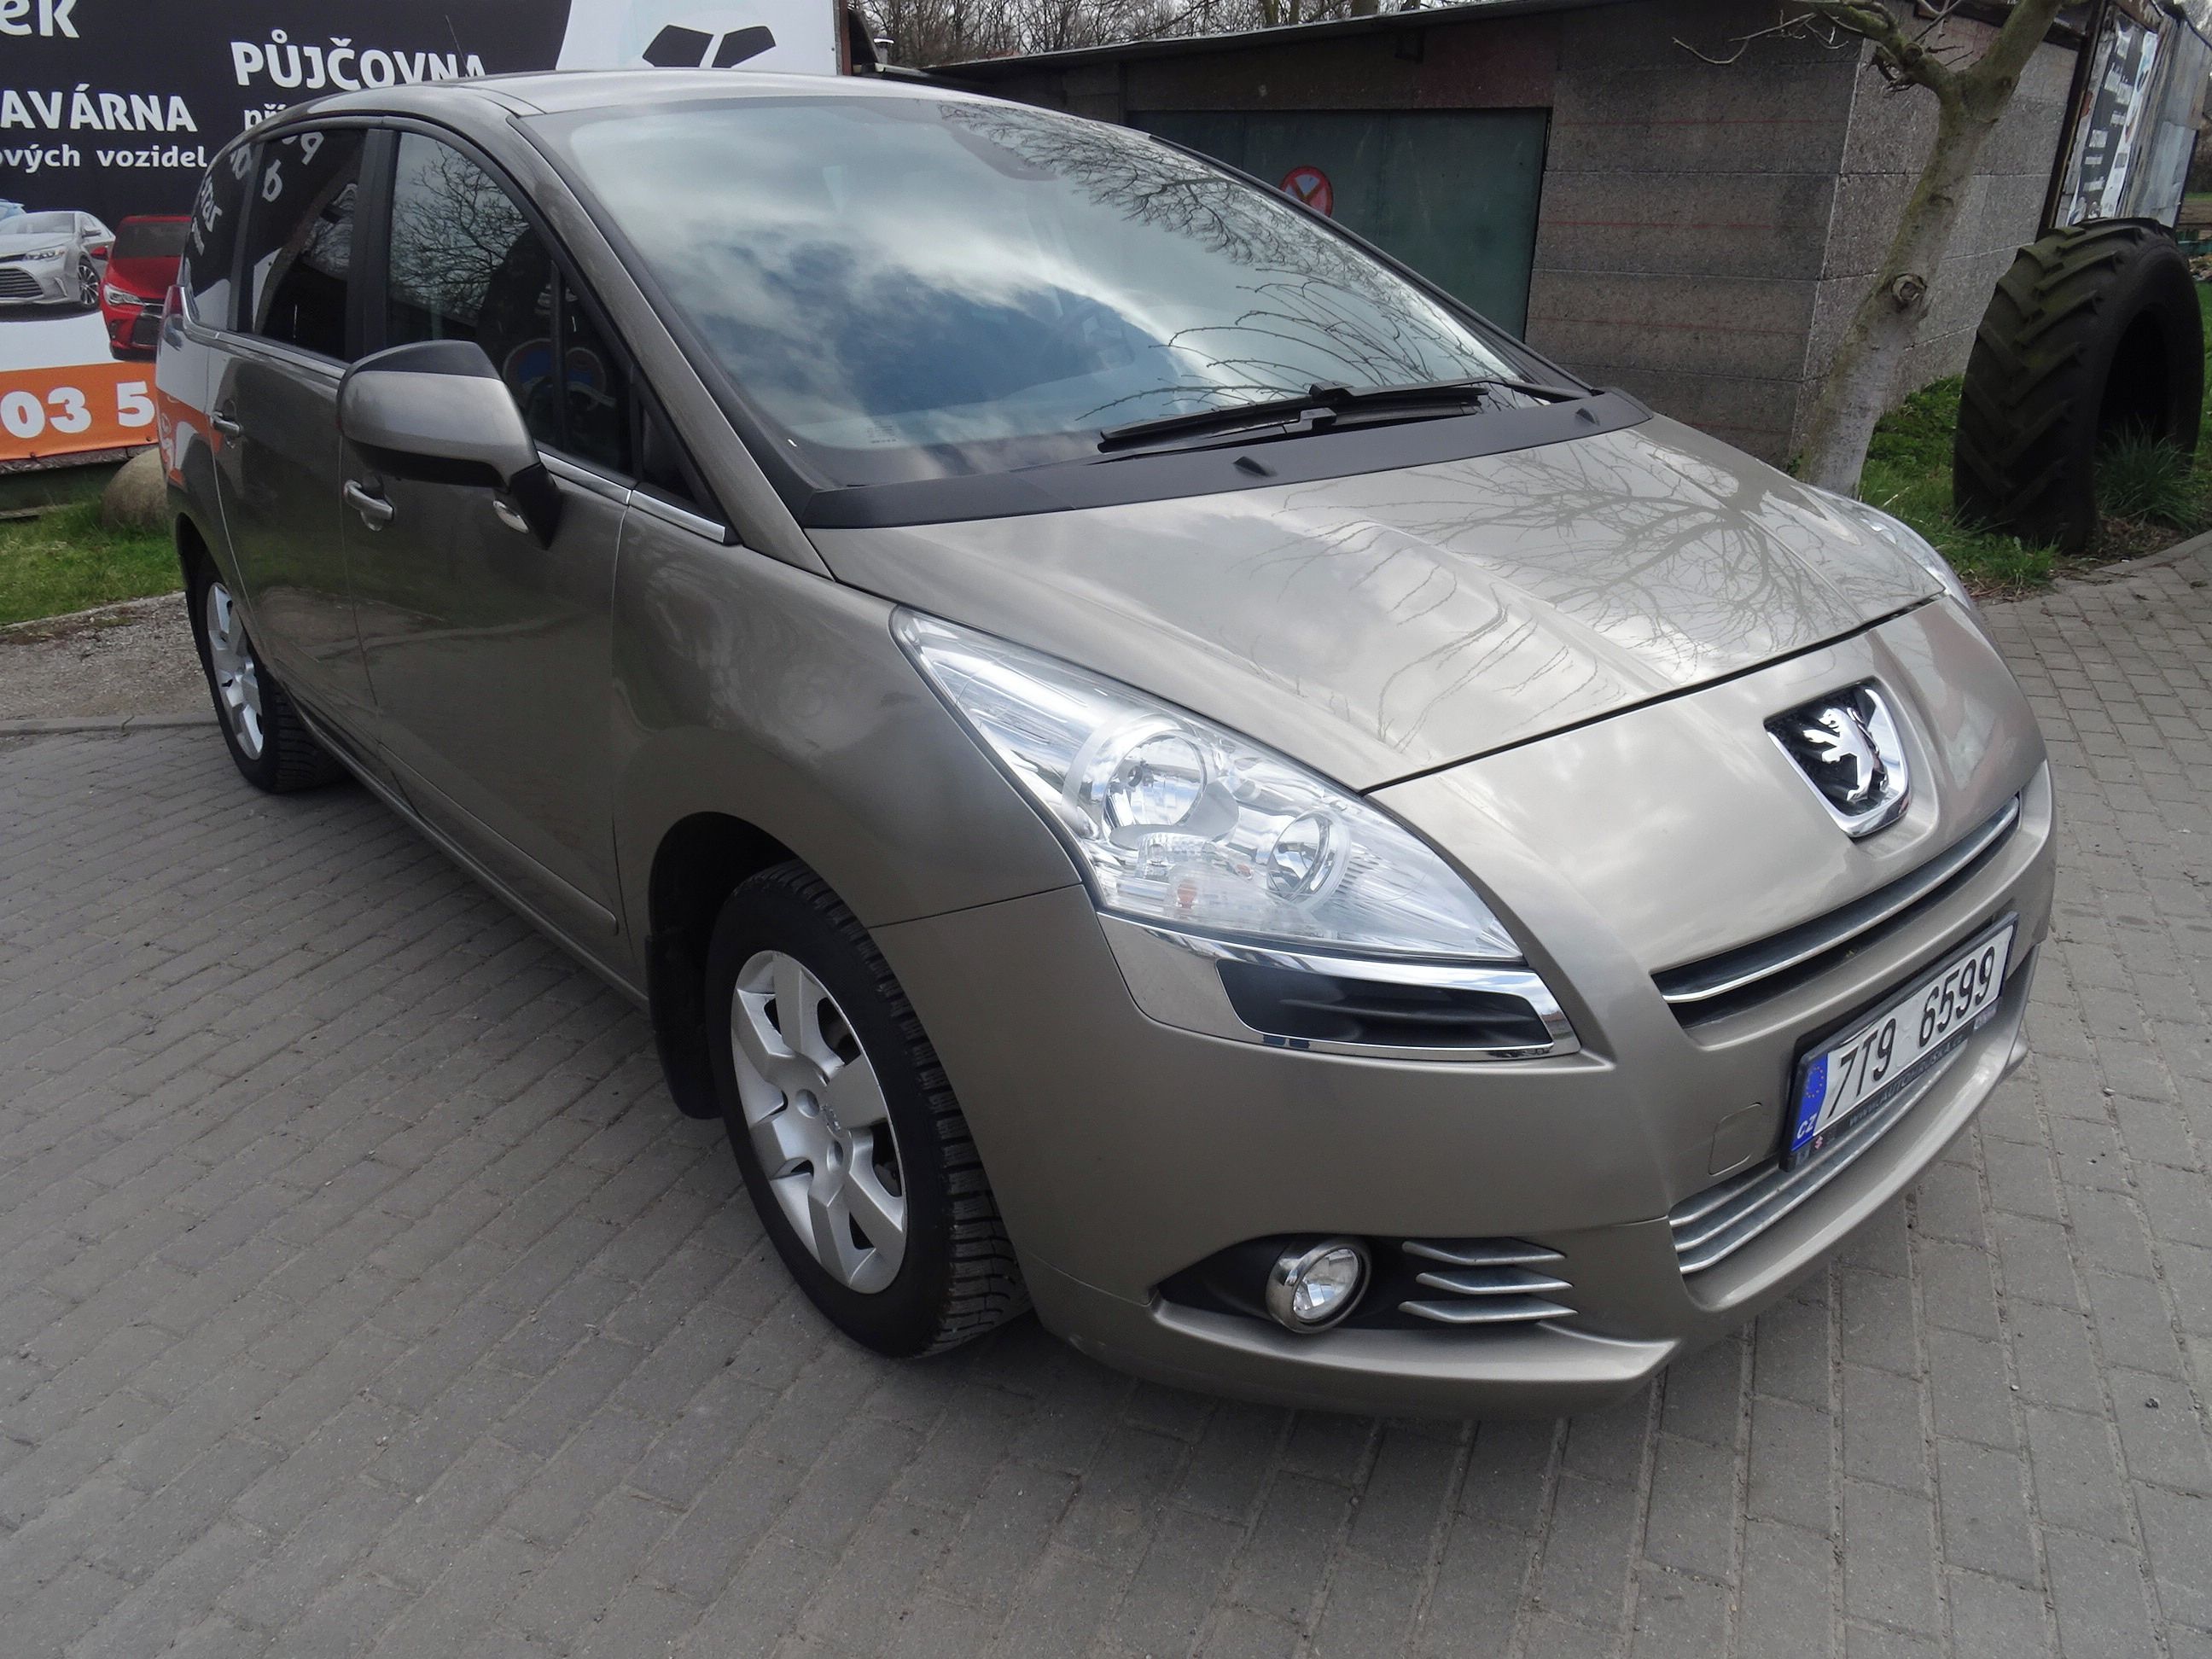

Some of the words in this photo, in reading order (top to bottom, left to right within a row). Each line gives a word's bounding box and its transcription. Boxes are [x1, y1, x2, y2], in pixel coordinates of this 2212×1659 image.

[230, 28, 486, 90] PŮJČOVNA
[0, 84, 199, 131] AVÁRNA
[0, 143, 81, 173] vých
[96, 144, 208, 167] vozidel
[0, 386, 92, 439] 03
[116, 381, 155, 428] 5
[1828, 1017, 1896, 1119] 7T9
[1918, 946, 1995, 1048] 6599
[1796, 1112, 1817, 1139] CZ
